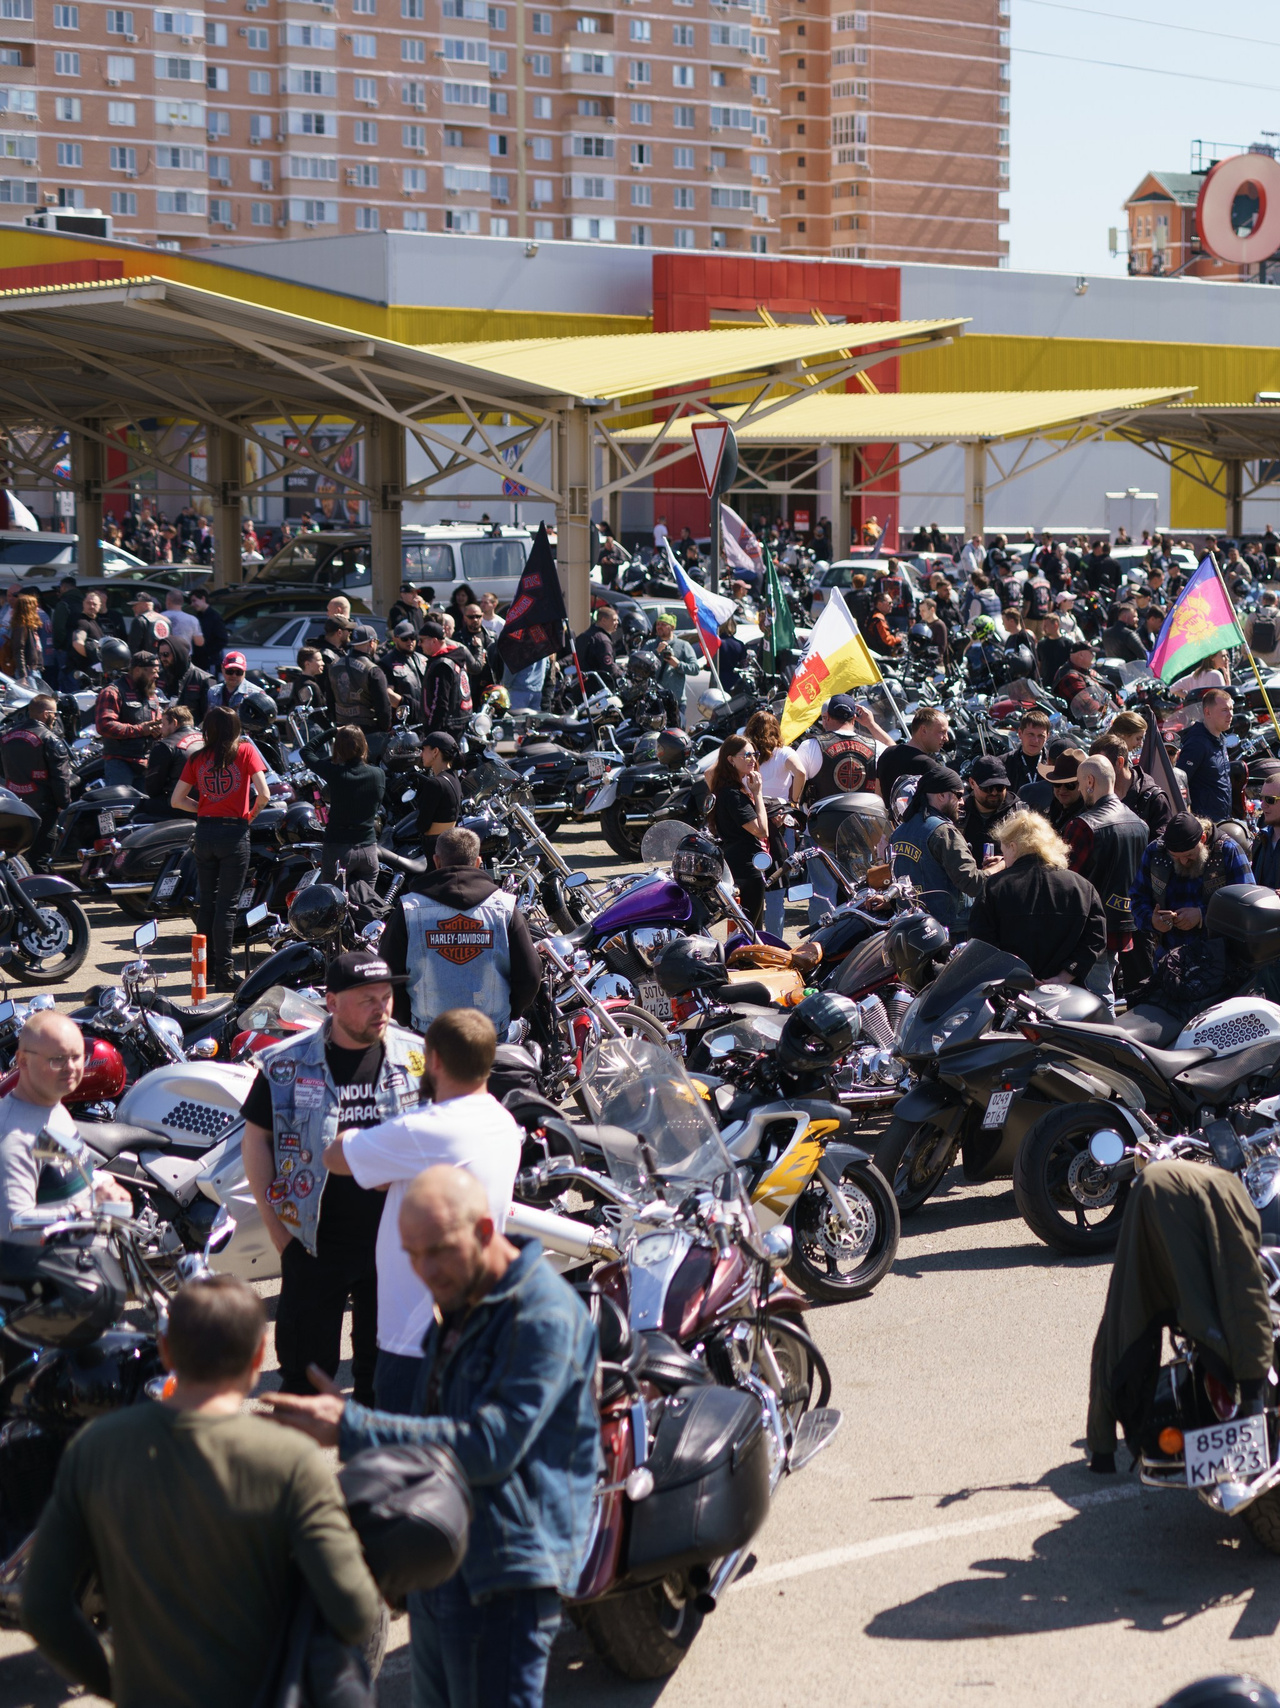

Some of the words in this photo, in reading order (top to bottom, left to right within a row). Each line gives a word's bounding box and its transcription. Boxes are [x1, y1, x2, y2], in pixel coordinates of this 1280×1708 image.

[894, 844, 919, 860] PANIS
[1114, 899, 1130, 910] KU
[445, 921, 476, 930] MOTOR
[430, 934, 489, 944] HARLEY-DAVIDSON
[443, 948, 476, 960] CYCLES
[658, 1004, 669, 1016] 23
[992, 1093, 1010, 1105] 0249
[996, 1110, 1006, 1122] 61
[1197, 1424, 1252, 1452] 8585
[1234, 1451, 1260, 1472] 23
